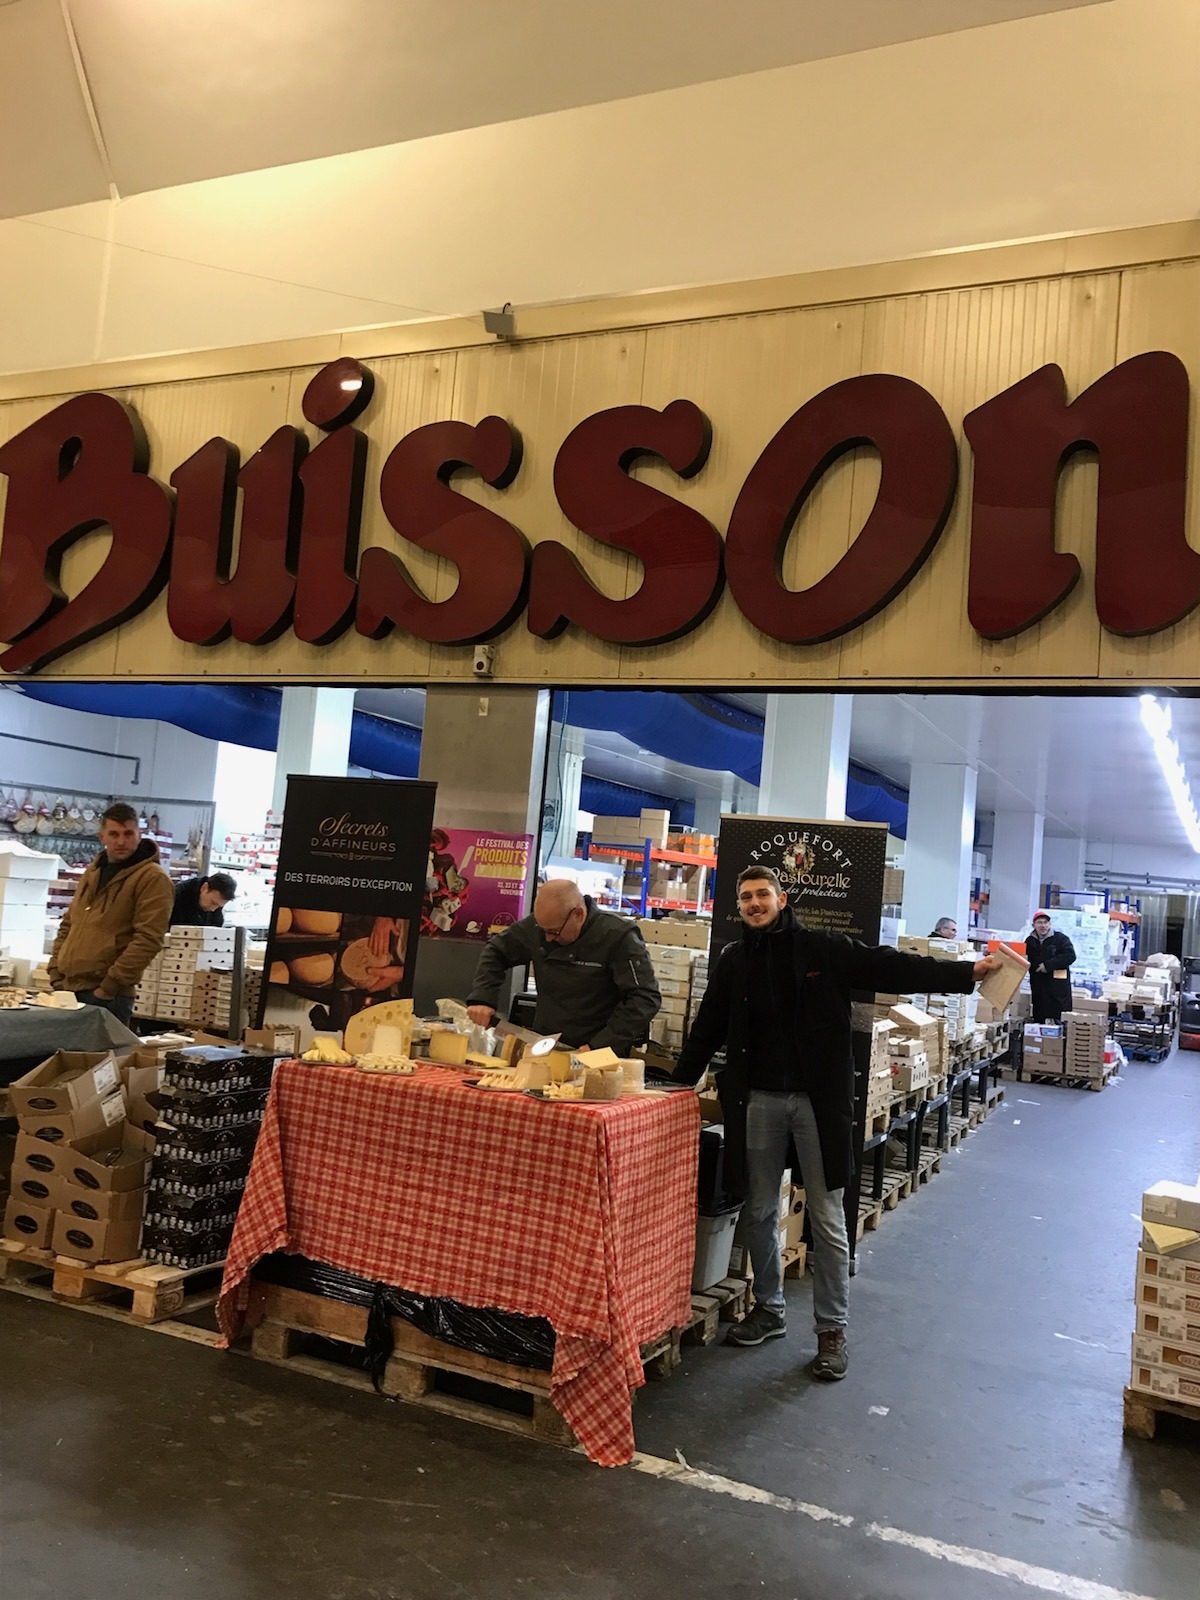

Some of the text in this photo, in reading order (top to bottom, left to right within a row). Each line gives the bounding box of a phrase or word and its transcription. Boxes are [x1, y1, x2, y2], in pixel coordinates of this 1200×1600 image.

[0, 350, 1200, 675] Buisson
[318, 811, 389, 837] Secrets
[310, 837, 397, 853] D'AFFINEURS
[476, 838, 530, 850] LE FESTIVAL DES
[750, 831, 853, 868] ROQUEFORT
[473, 848, 528, 865] PRODUITS
[284, 871, 413, 892] DES TERROIRS D'EXCEPTION
[794, 885, 848, 903] producteurs
